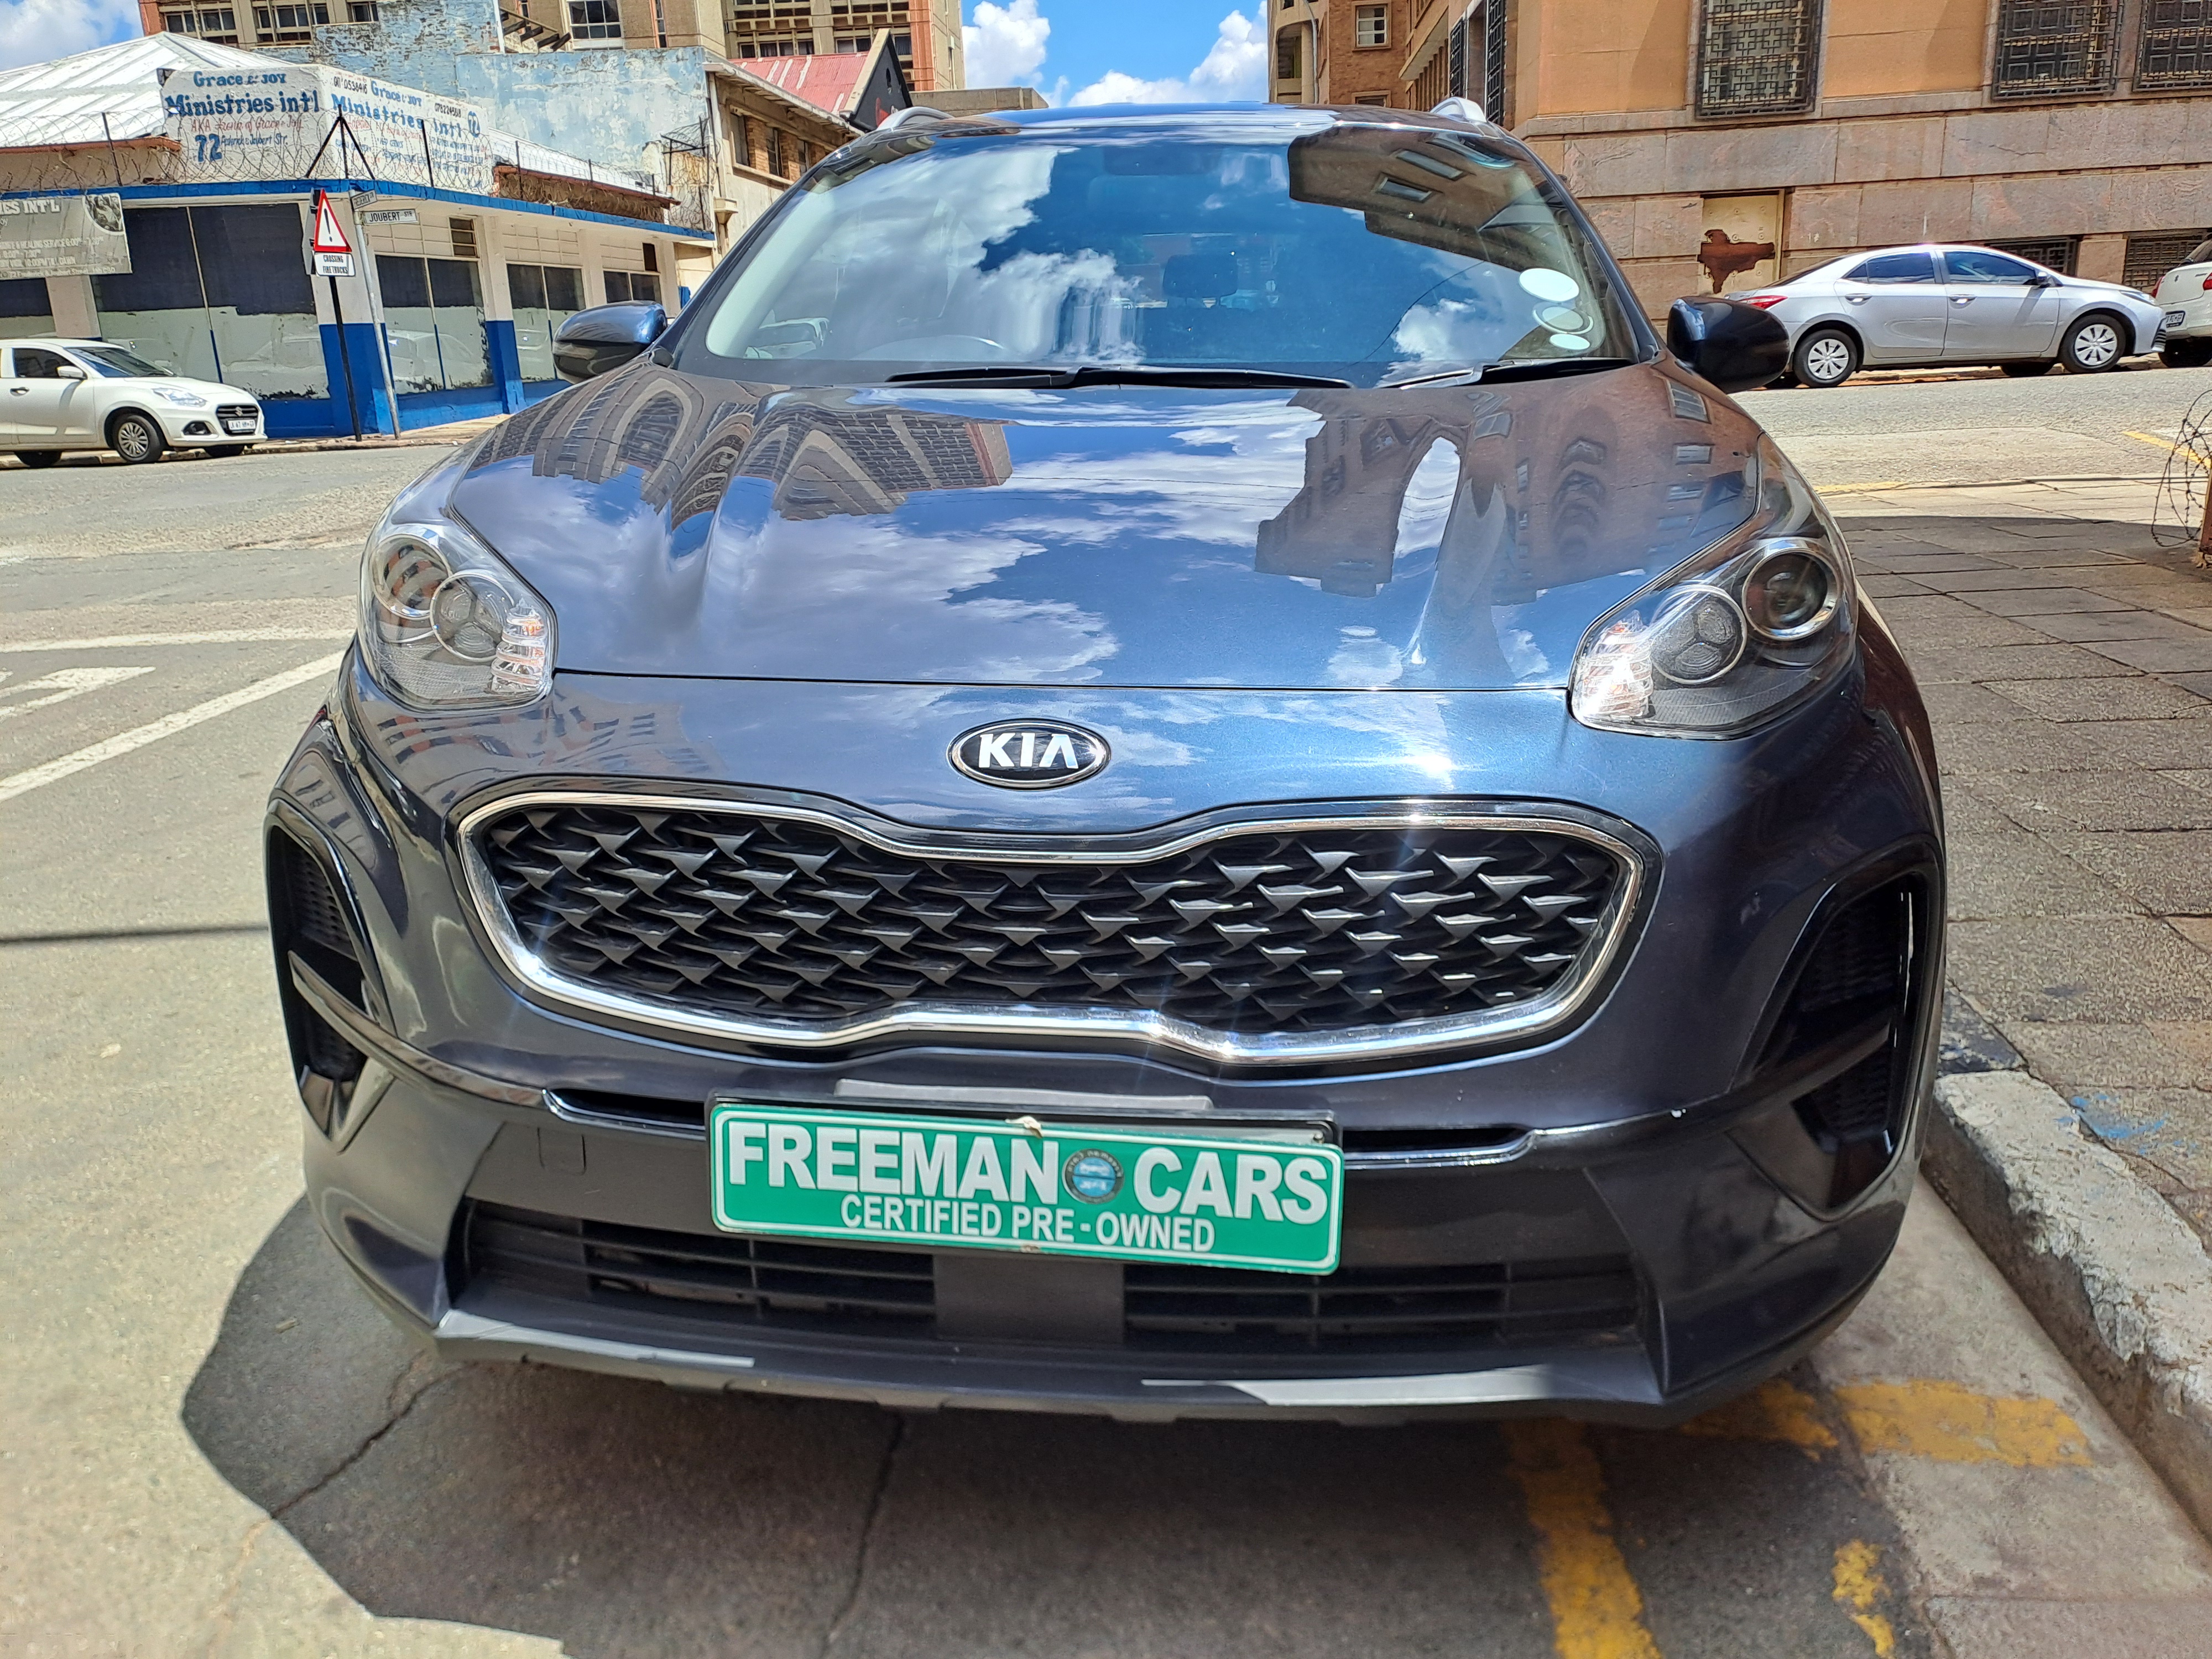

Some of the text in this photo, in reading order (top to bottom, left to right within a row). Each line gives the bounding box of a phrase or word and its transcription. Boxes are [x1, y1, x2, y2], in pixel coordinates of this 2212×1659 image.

[194, 71, 243, 87] Grace
[260, 72, 286, 85] JOY
[371, 80, 401, 102] Grace
[165, 93, 275, 118] Ministries
[331, 93, 424, 129] Ministries
[191, 118, 211, 133] AKA
[195, 133, 222, 163] 72
[23, 199, 60, 213] INT'L
[369, 211, 400, 222] JOUBERT
[323, 254, 344, 263] CROSSING
[332, 266, 348, 274] TRUCKS
[978, 732, 1078, 769] KIA
[728, 1120, 1059, 1204] FREEMAN
[1133, 1146, 1328, 1225] CARS
[841, 1193, 1002, 1237] CERTIFIED
